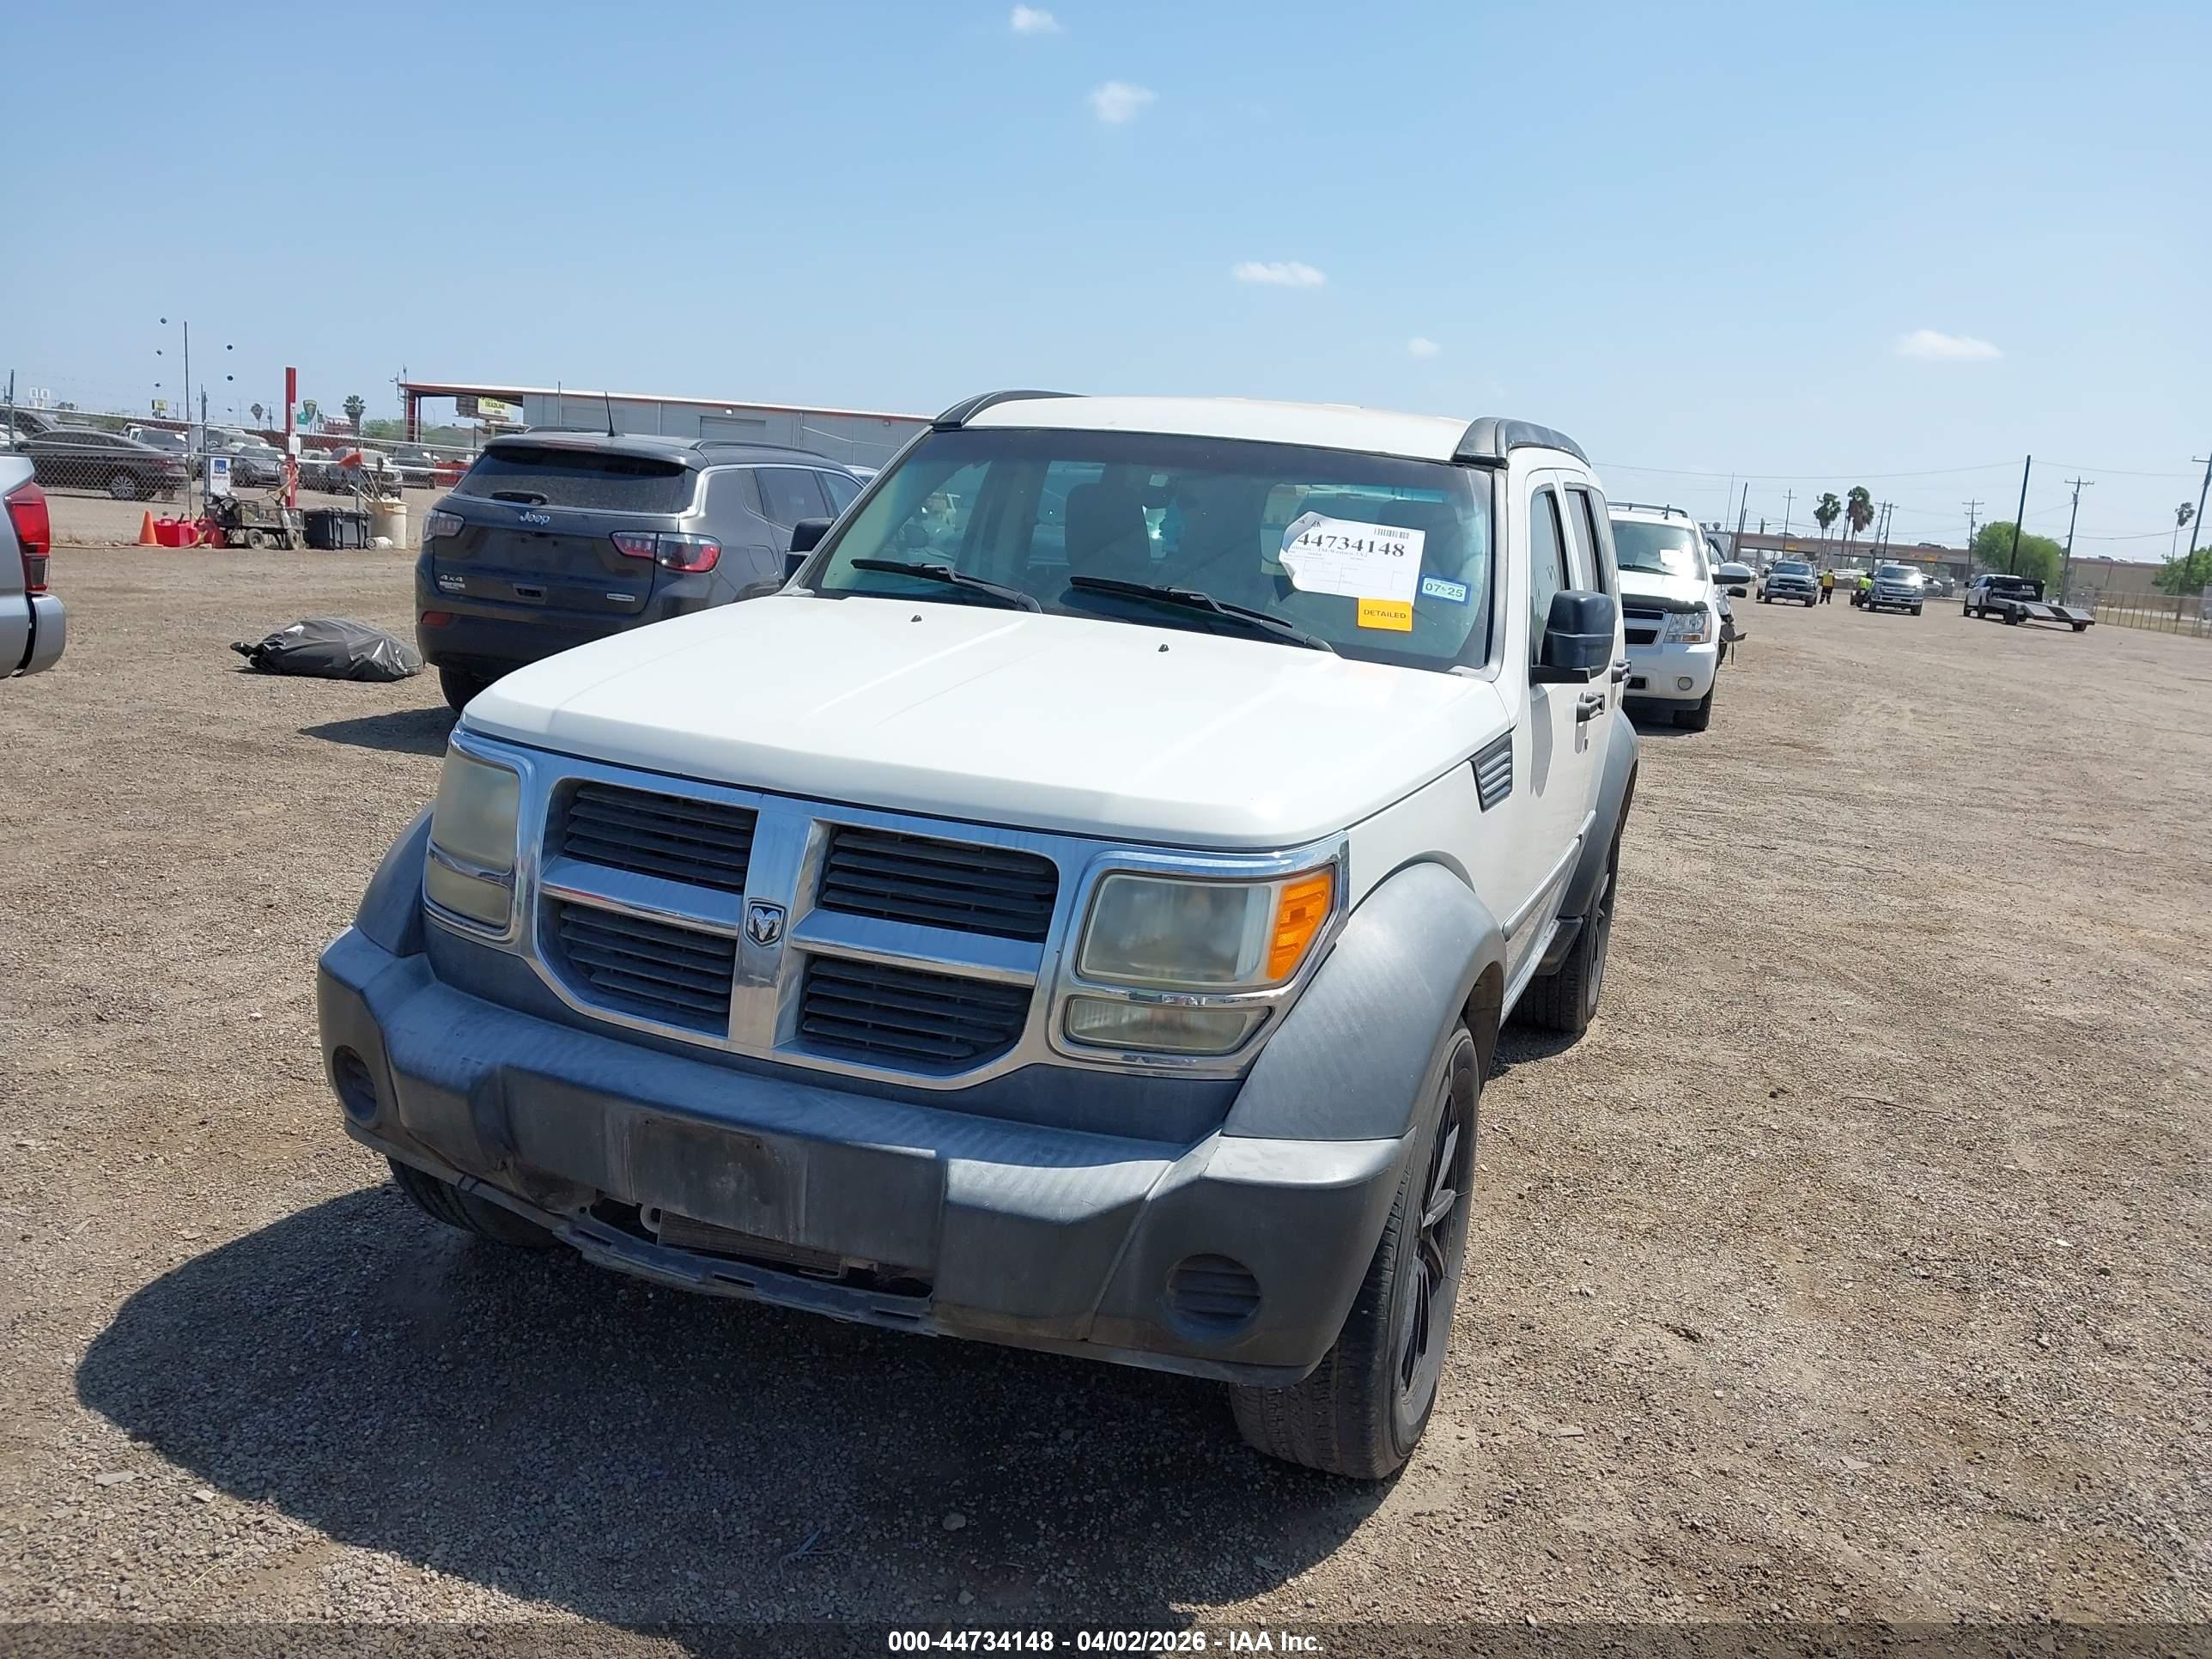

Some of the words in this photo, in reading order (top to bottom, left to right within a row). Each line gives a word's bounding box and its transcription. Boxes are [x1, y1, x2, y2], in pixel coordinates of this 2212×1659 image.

[519, 511, 550, 526] Jeep
[1297, 532, 1405, 557] 44734148
[1364, 609, 1407, 619] DETAILED
